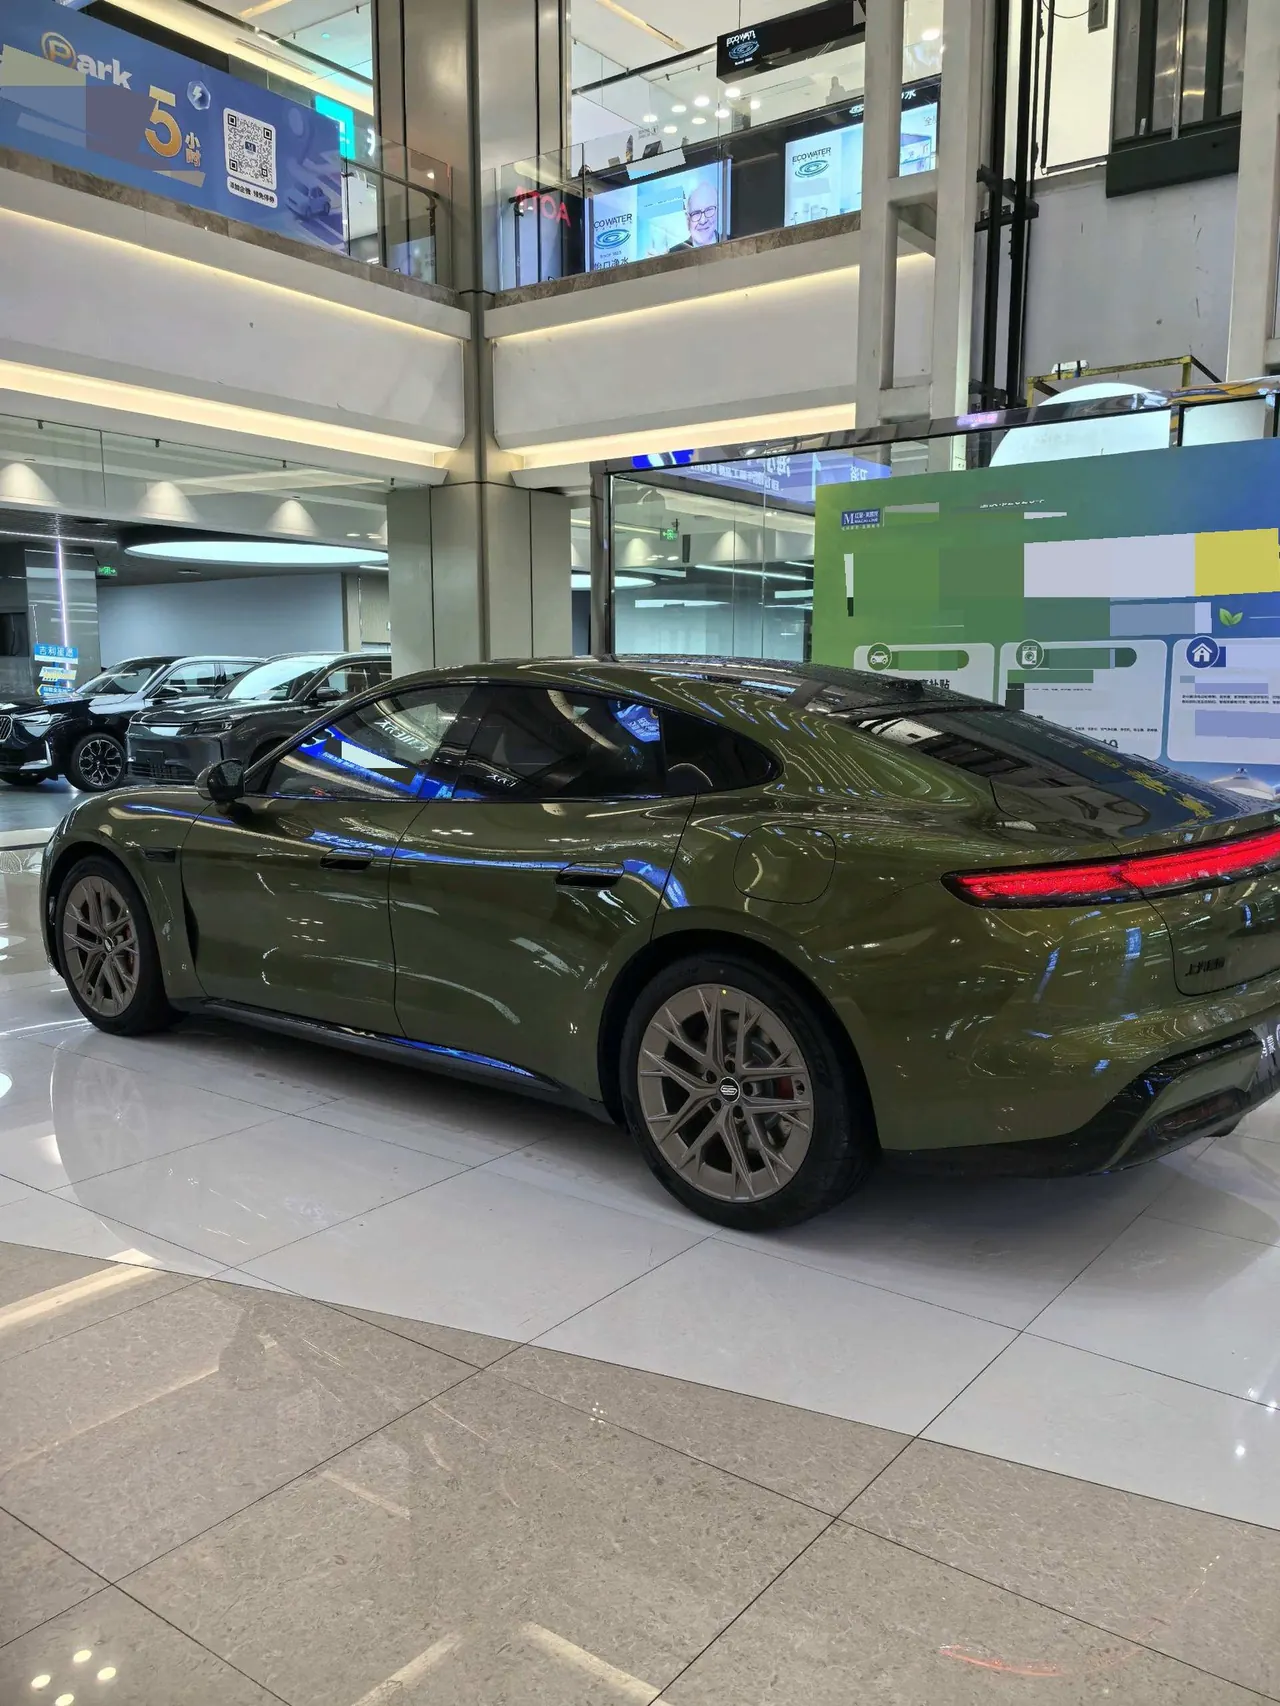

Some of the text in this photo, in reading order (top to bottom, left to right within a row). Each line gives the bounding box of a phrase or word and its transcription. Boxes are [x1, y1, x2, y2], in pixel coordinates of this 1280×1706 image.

[47, 38, 132, 91] Park
[144, 85, 202, 168] 5 小时
[792, 147, 832, 164] ECOWATER
[593, 213, 633, 229] COWATER
